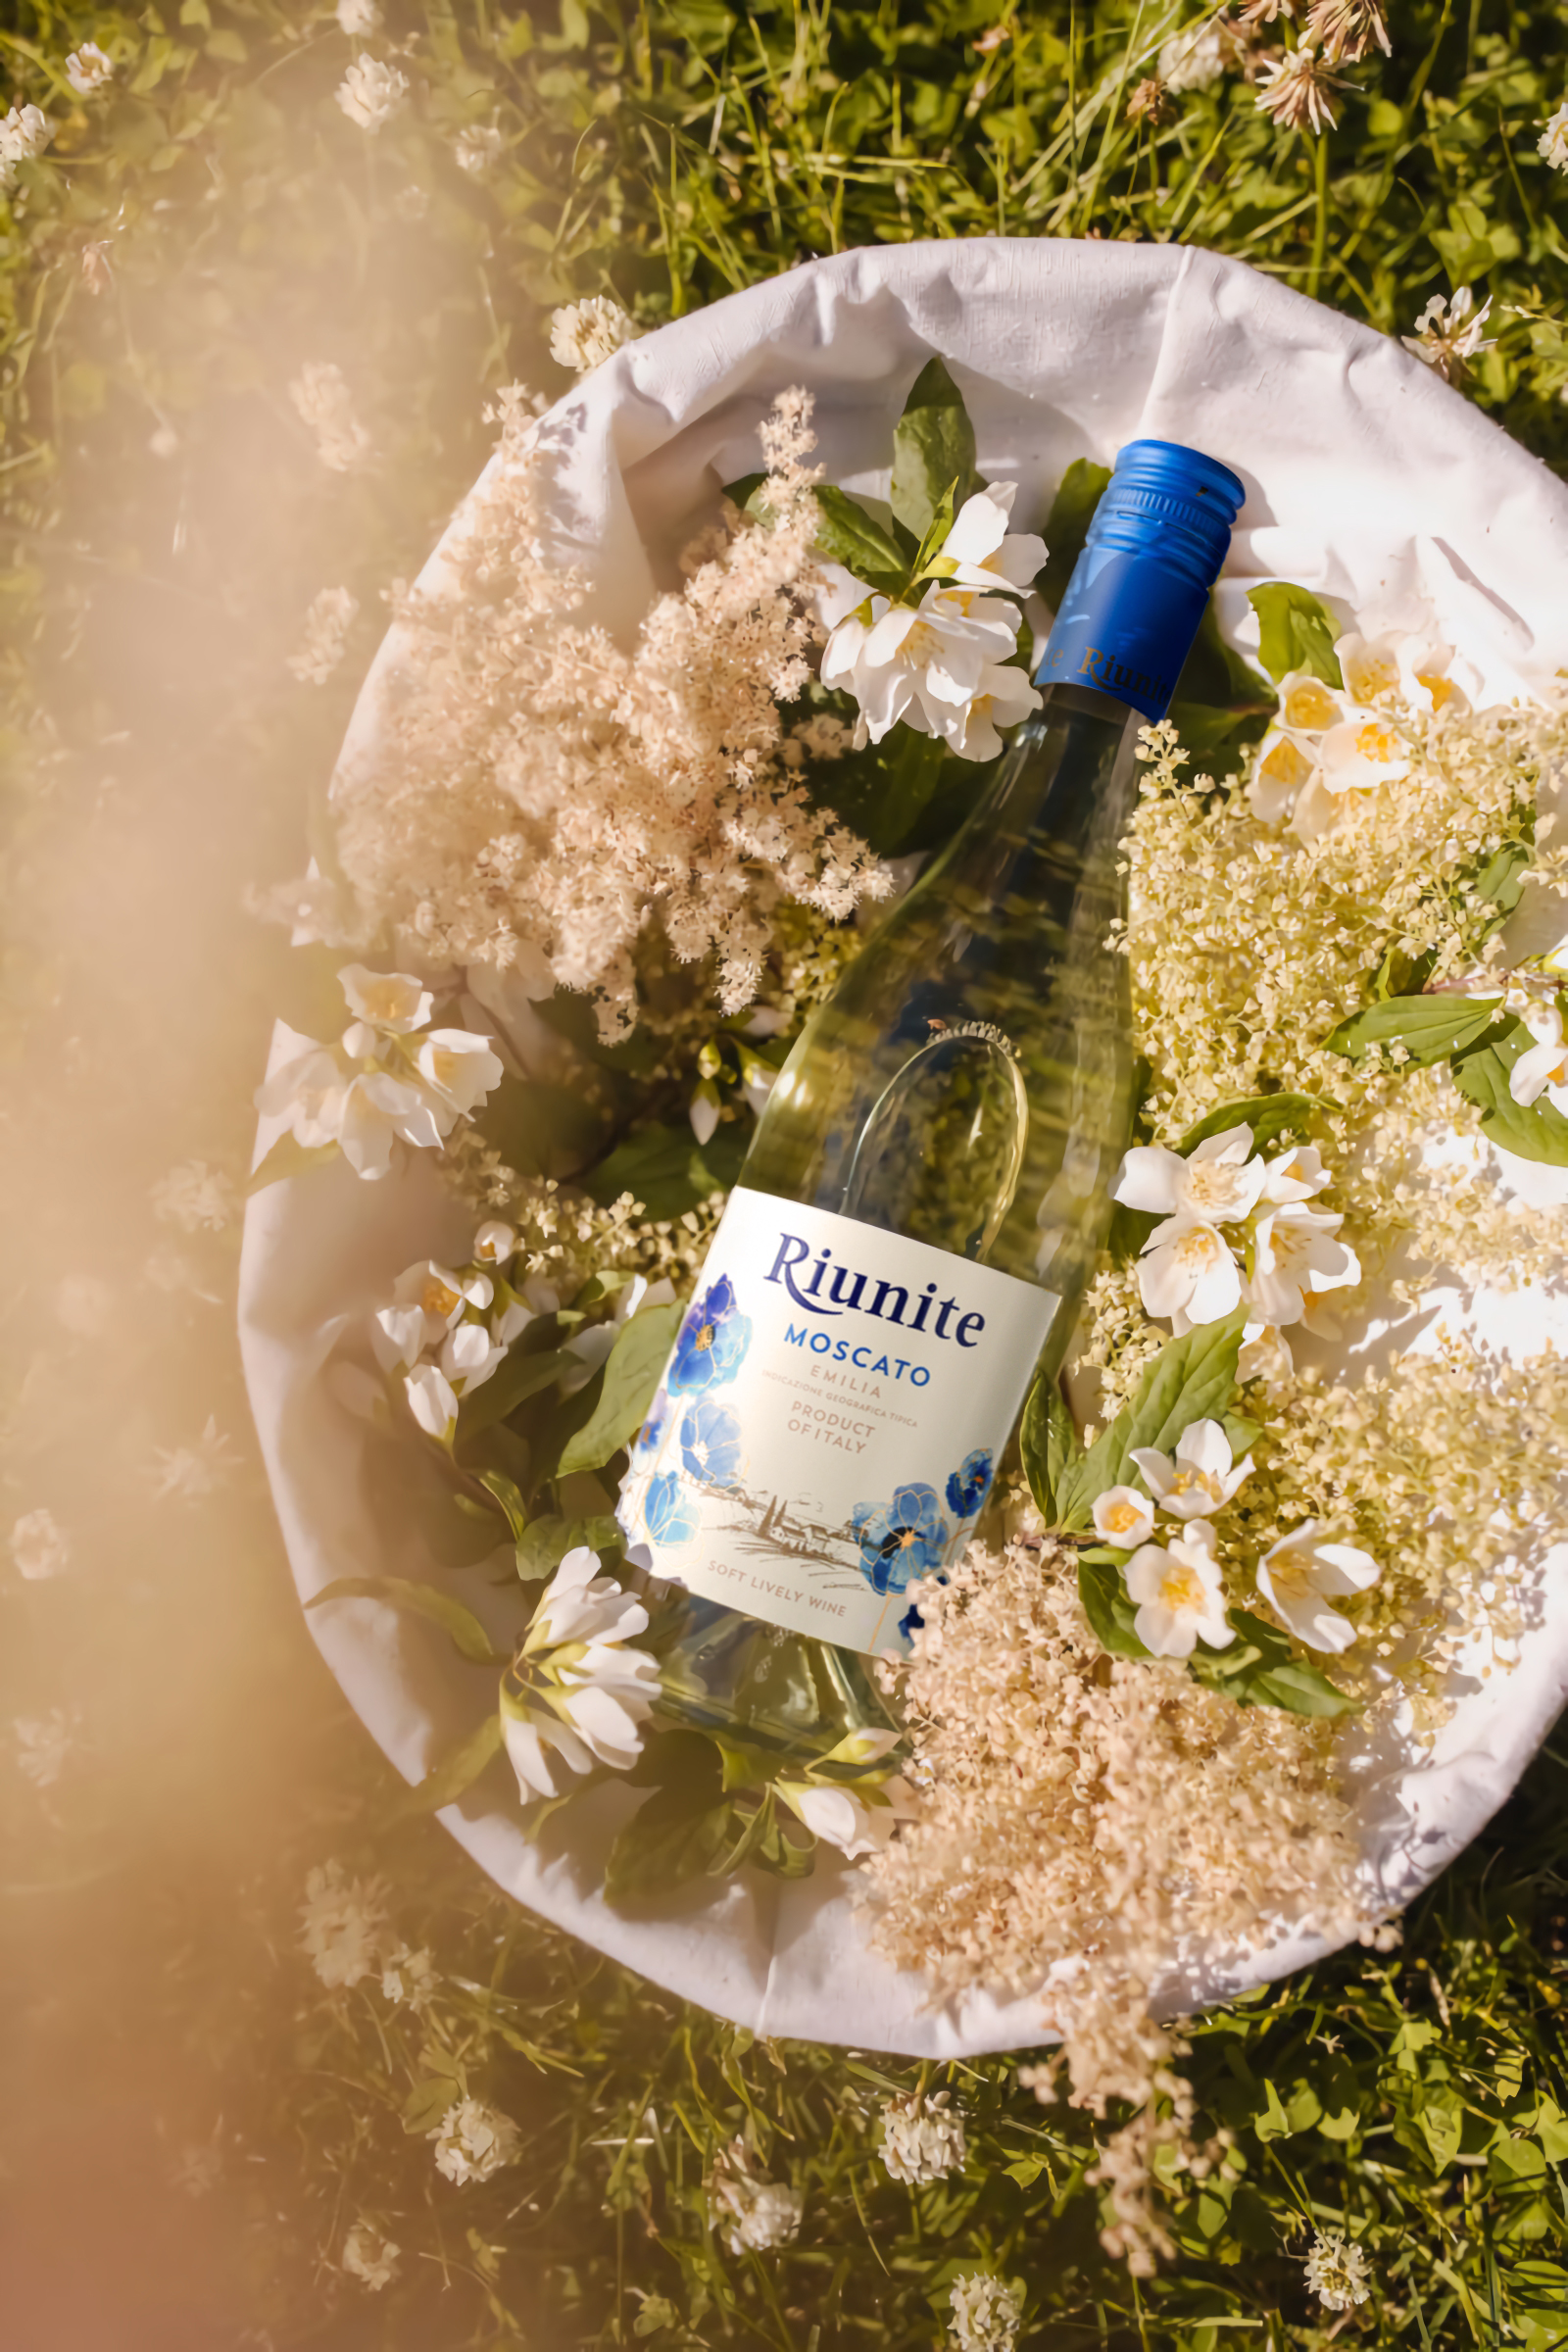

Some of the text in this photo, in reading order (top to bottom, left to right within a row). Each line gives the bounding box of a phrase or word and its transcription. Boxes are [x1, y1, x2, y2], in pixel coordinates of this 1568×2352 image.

[763, 1232, 986, 1348] Riunite
[784, 1323, 931, 1387] MOSCATO
[810, 1364, 881, 1398] EMILIA
[761, 1369, 918, 1428] INDICAZIONE GEOGRAFICA TIPICA
[791, 1400, 875, 1438] PRODUCT
[788, 1419, 866, 1454] OF ITALY
[708, 1560, 847, 1617] SOFT LIVELY WINE
